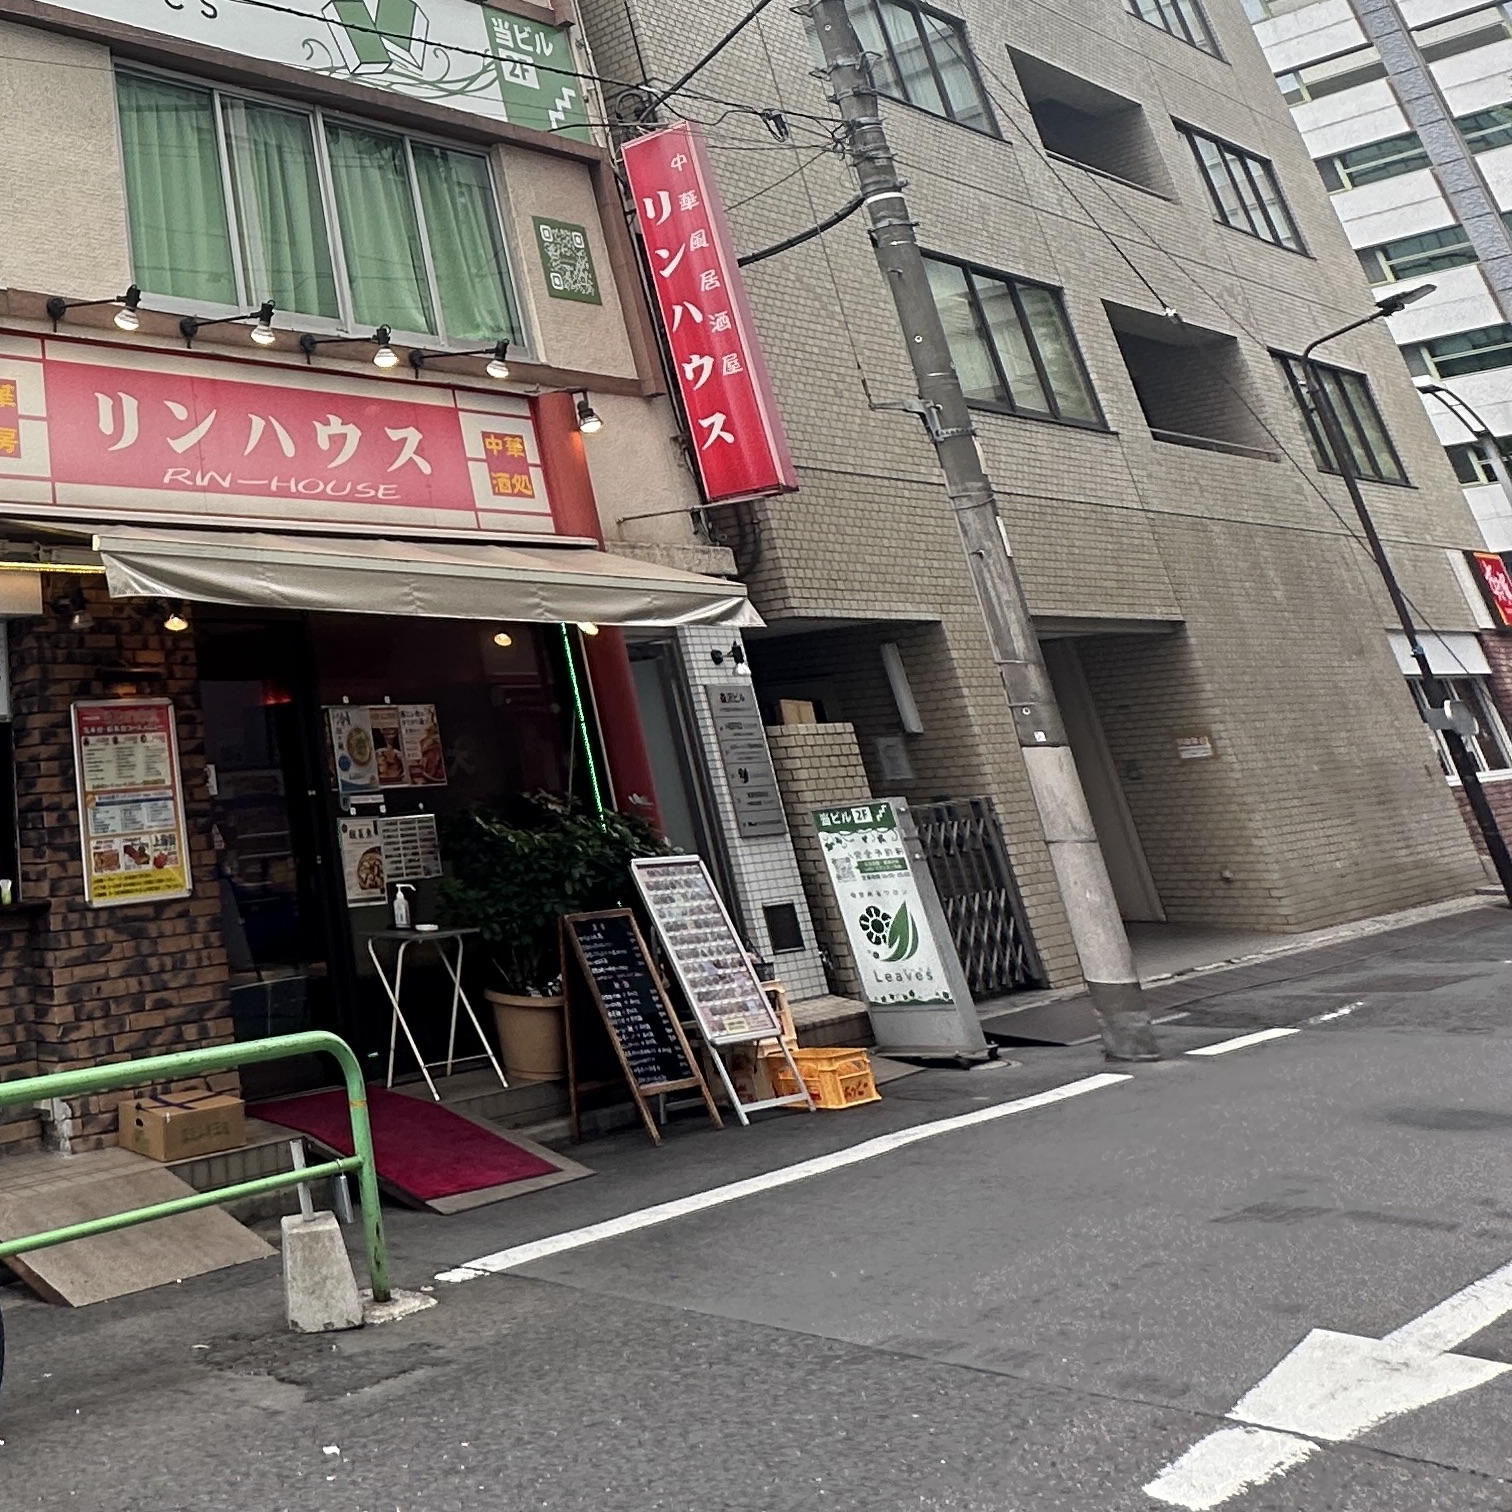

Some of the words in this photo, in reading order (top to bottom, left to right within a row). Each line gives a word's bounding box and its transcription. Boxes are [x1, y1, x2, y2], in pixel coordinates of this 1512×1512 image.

[491, 17, 554, 57] 当ビル
[506, 54, 530, 81] 2F
[643, 190, 734, 451] リンハウス
[94, 391, 432, 475] リンハウス
[485, 434, 526, 457] 中華
[855, 809, 868, 821] 2F
[873, 969, 933, 983] Leaves
